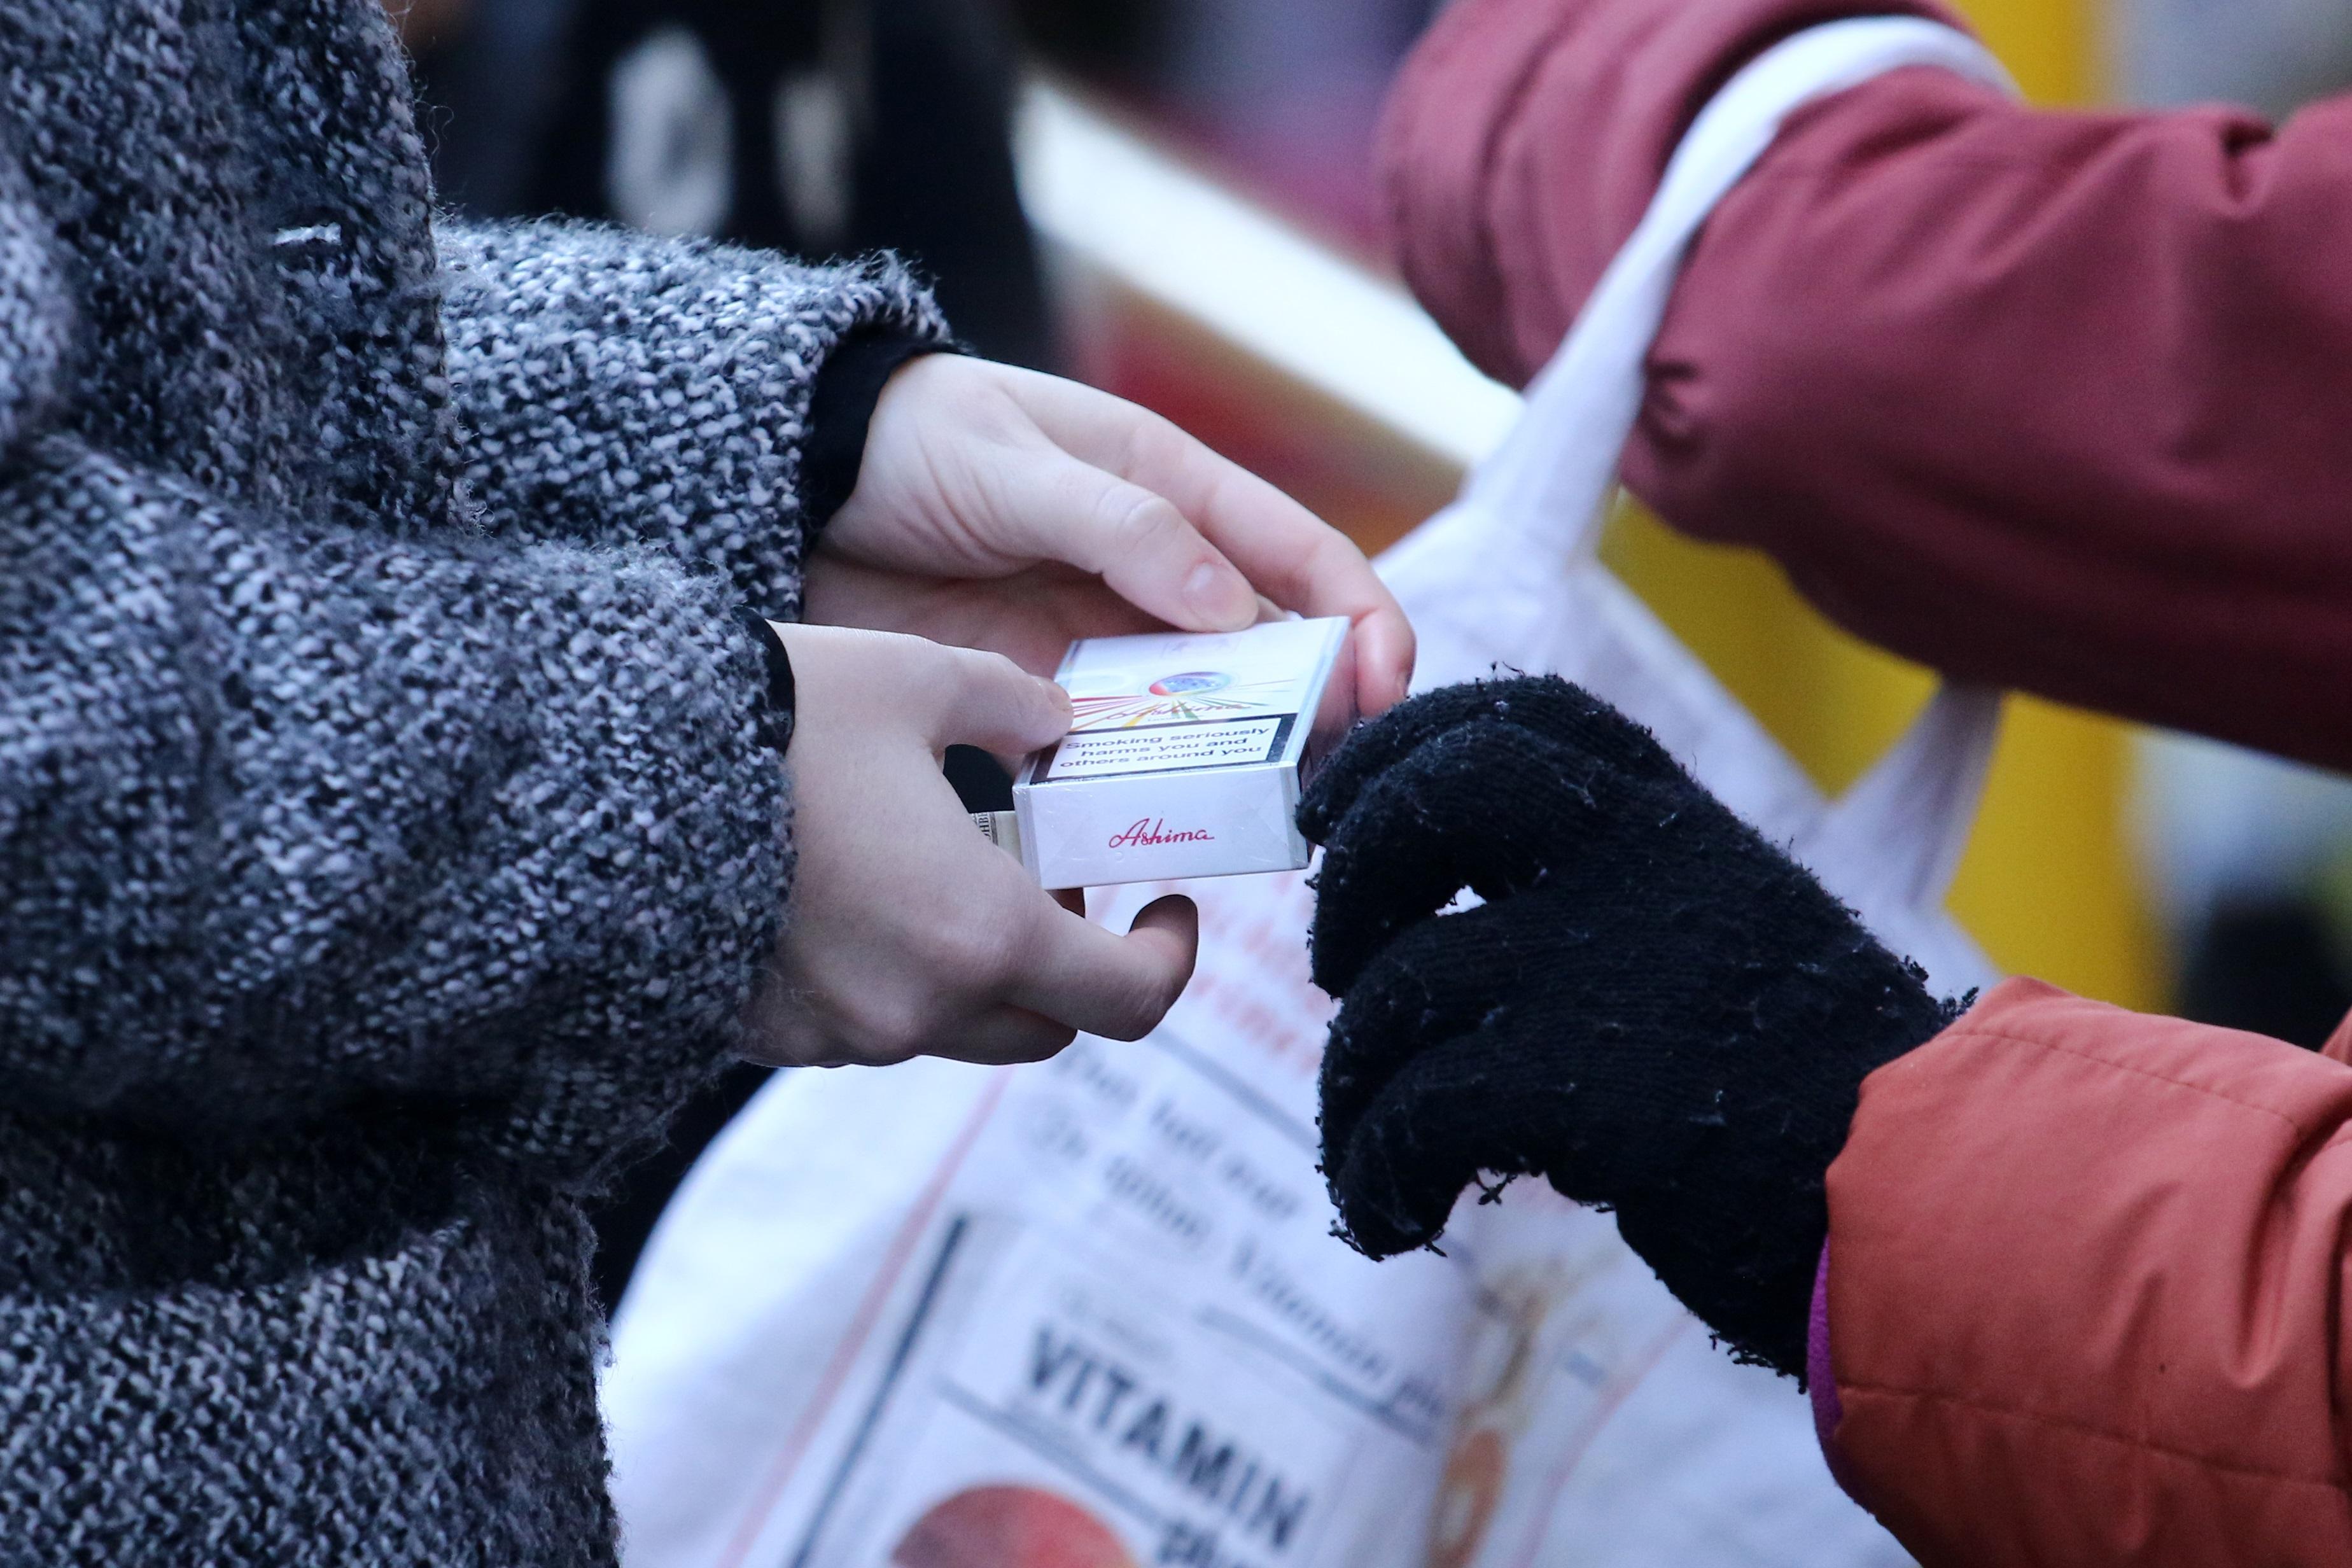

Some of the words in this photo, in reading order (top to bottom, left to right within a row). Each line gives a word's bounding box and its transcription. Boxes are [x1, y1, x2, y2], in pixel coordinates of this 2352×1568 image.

[1106, 701, 1252, 720] Ashima
[1065, 737, 1163, 749] Smoking
[1170, 728, 1270, 741] seriously
[1081, 747, 1151, 757] harms
[1159, 743, 1200, 752] you
[1206, 738, 1248, 747] and
[1060, 757, 1130, 767] others
[1137, 750, 1215, 762] around
[1221, 746, 1262, 756] you
[1108, 818, 1215, 848] Ashima
[1030, 1320, 1311, 1549] VITAMIN
